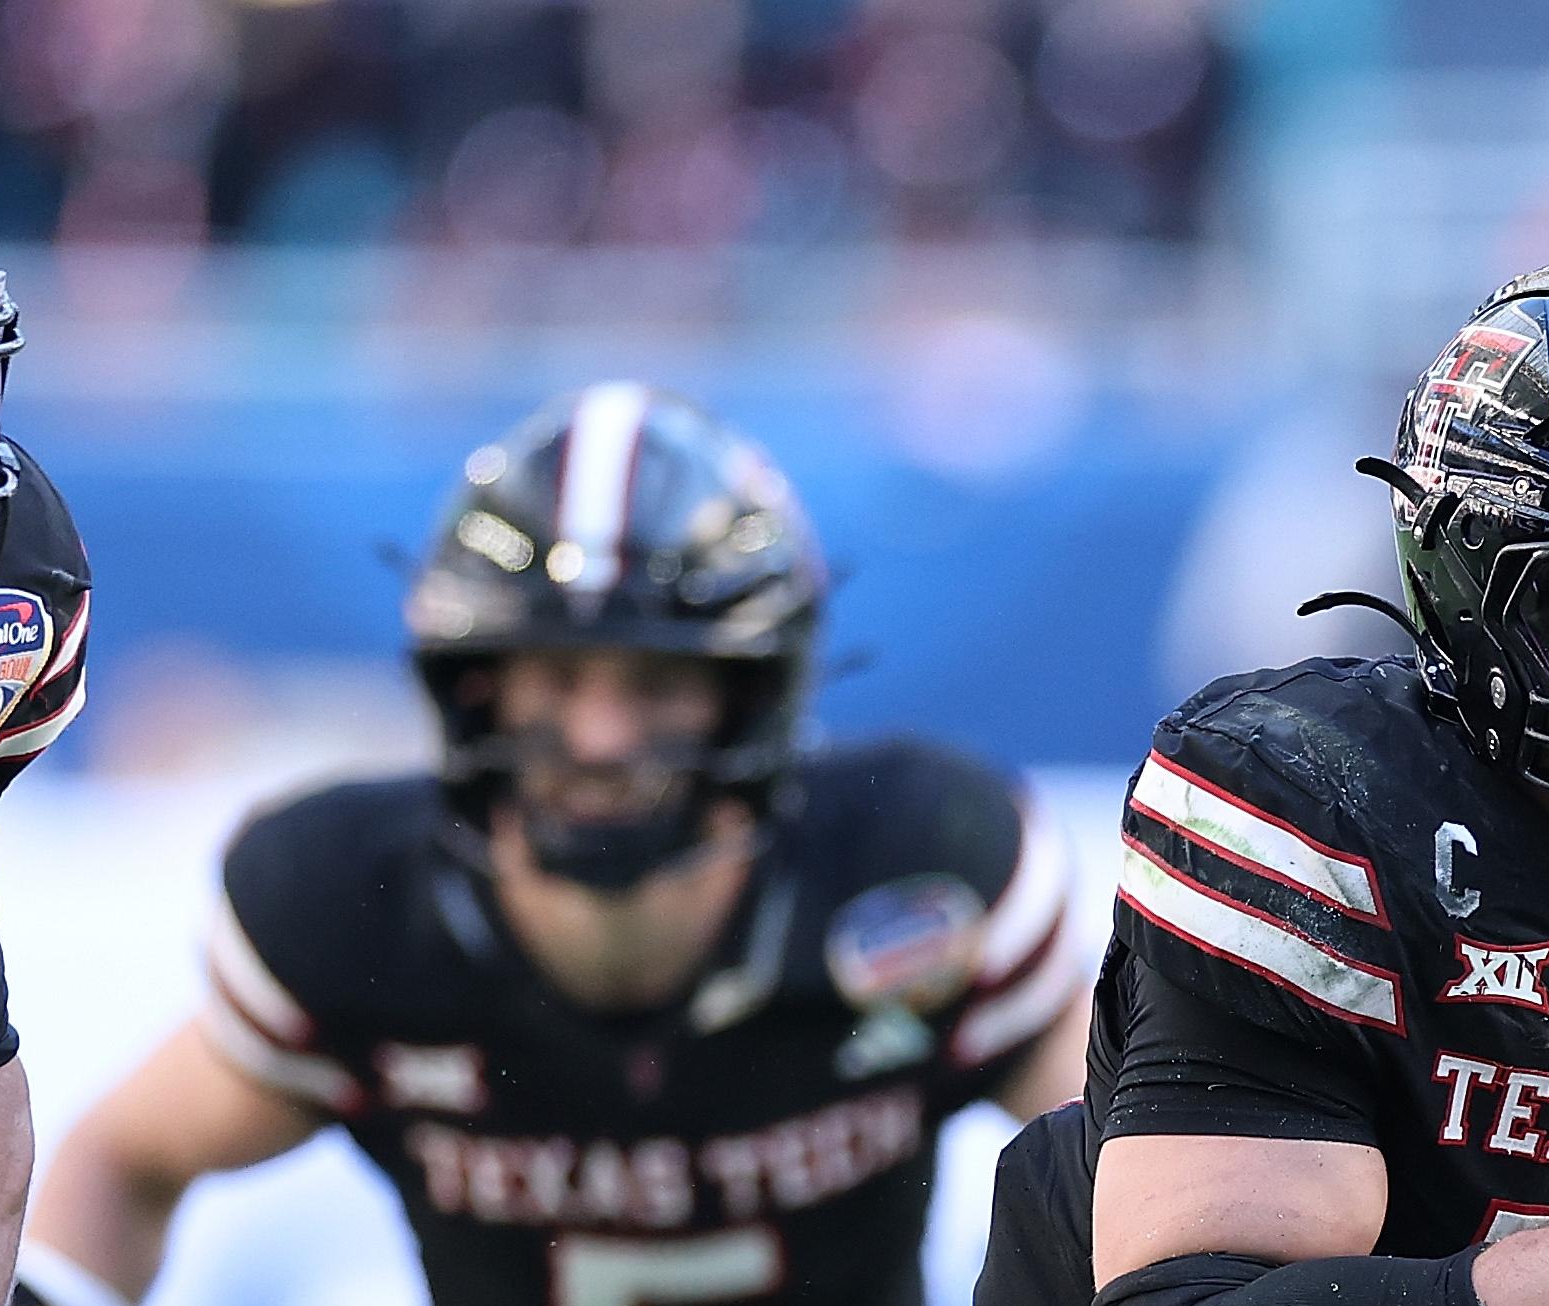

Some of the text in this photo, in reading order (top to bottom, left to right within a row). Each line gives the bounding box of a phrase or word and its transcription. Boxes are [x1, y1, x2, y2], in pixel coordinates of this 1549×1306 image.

[1434, 821, 1482, 919] C
[404, 1084, 923, 1228] TEXAS TECH
